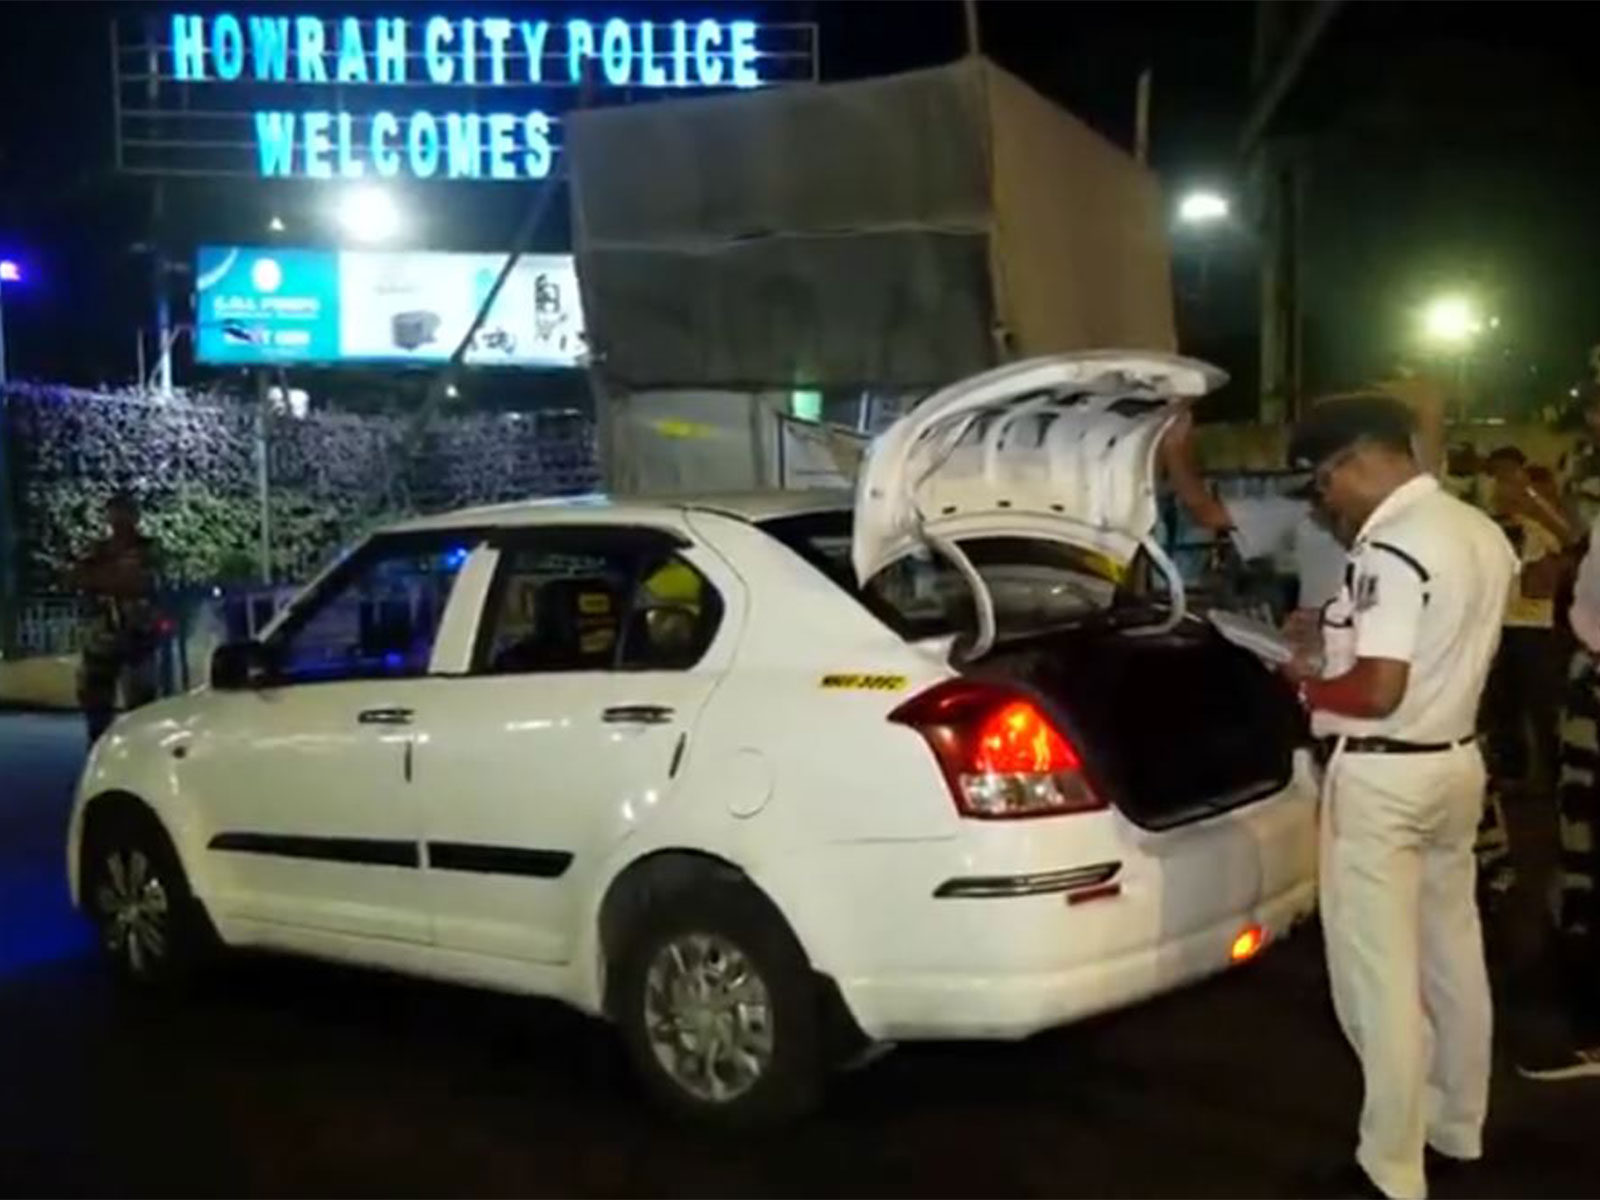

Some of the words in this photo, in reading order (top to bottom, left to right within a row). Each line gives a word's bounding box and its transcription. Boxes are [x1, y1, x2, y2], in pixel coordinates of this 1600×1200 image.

[172, 14, 405, 82] HOWRAH
[425, 16, 548, 84] CITY
[568, 18, 763, 87] POLICE
[255, 111, 553, 179] WELCOMES
